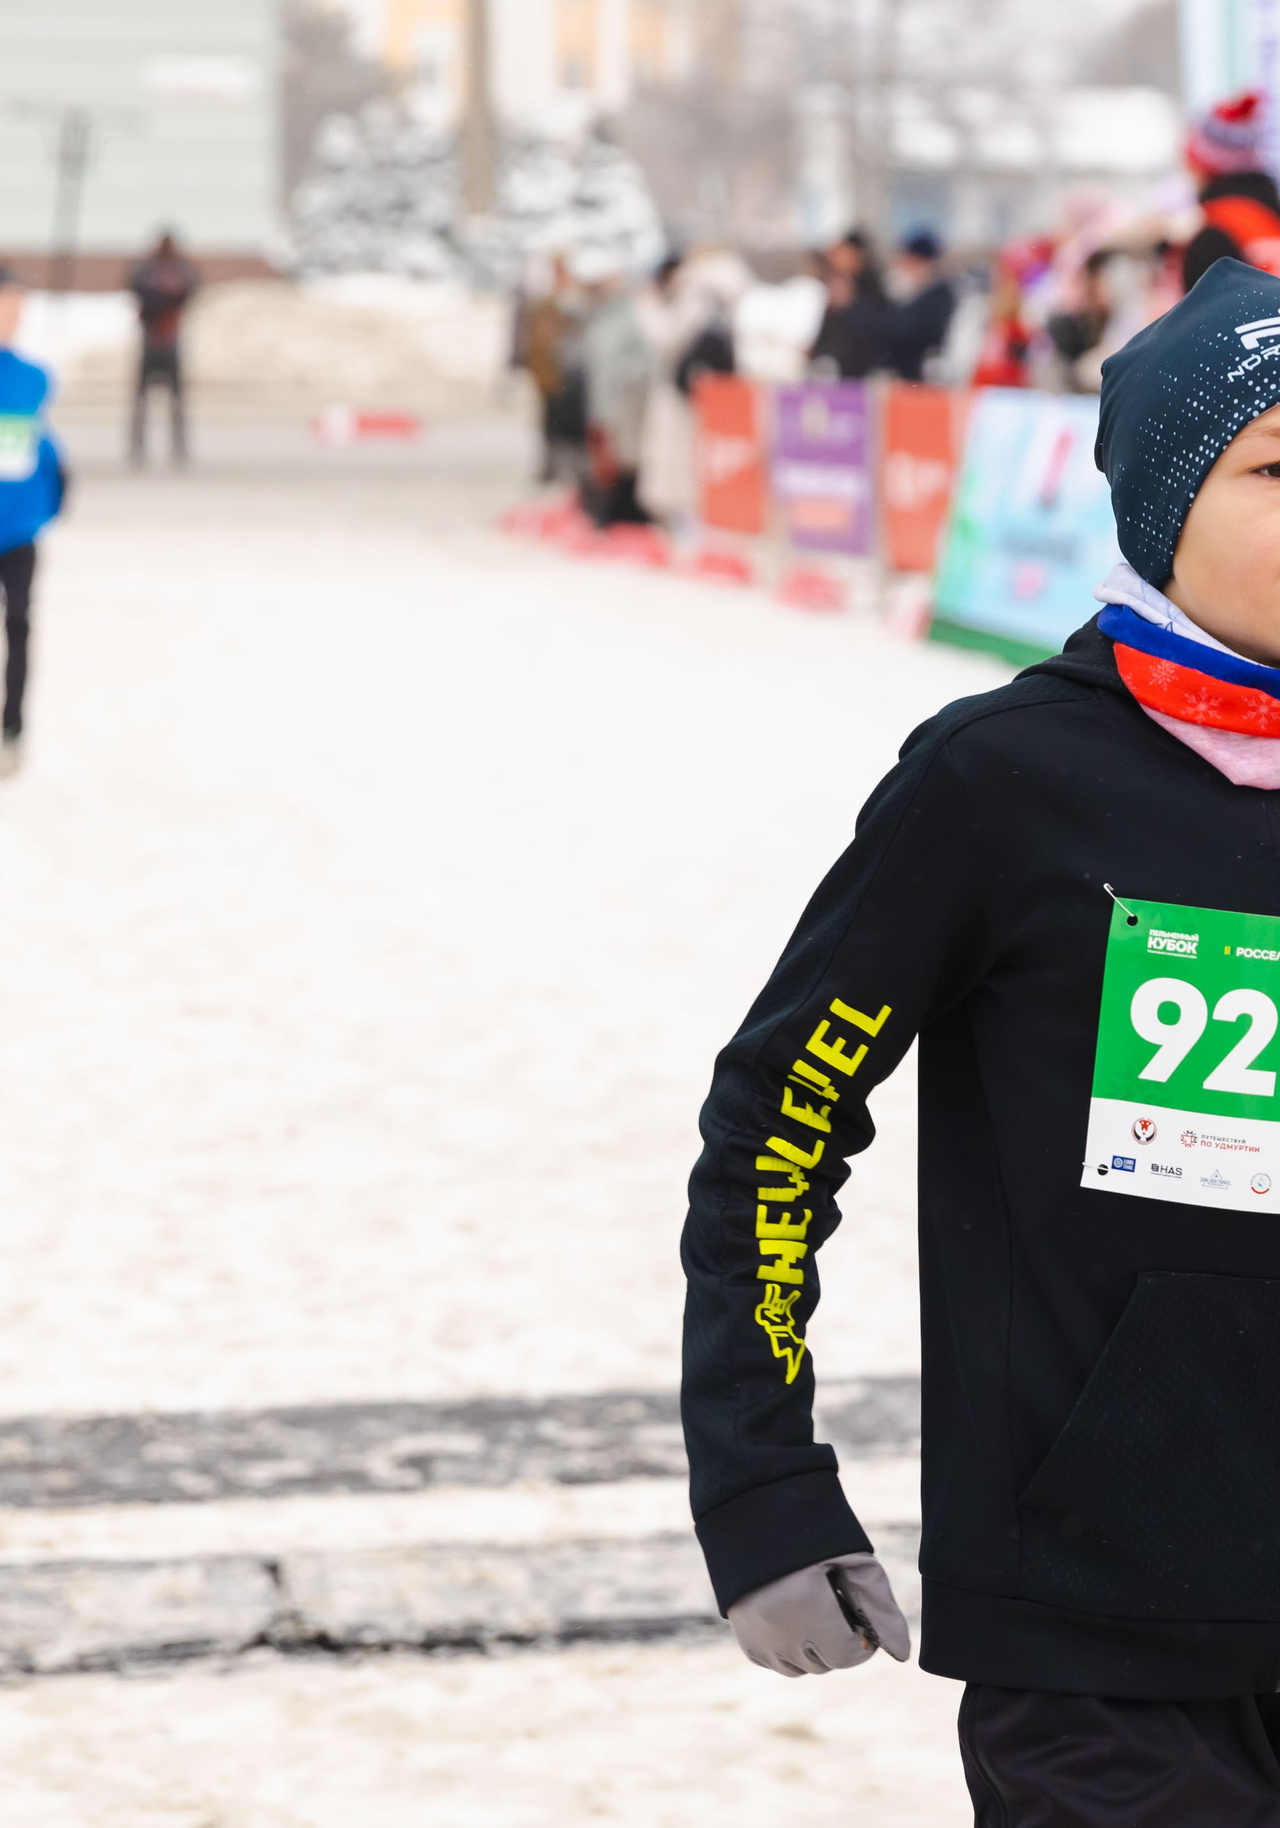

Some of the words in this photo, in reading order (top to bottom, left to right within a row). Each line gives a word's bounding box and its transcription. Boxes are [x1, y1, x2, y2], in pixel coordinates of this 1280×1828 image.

[1147, 936, 1198, 954] КУБОК
[1201, 1134, 1247, 1144] ПУТЕШЕСТВУЙ
[1200, 1140, 1212, 1148] ПО
[1215, 1142, 1260, 1153] УДМУРТИИ
[1159, 1165, 1183, 1176] HAS
